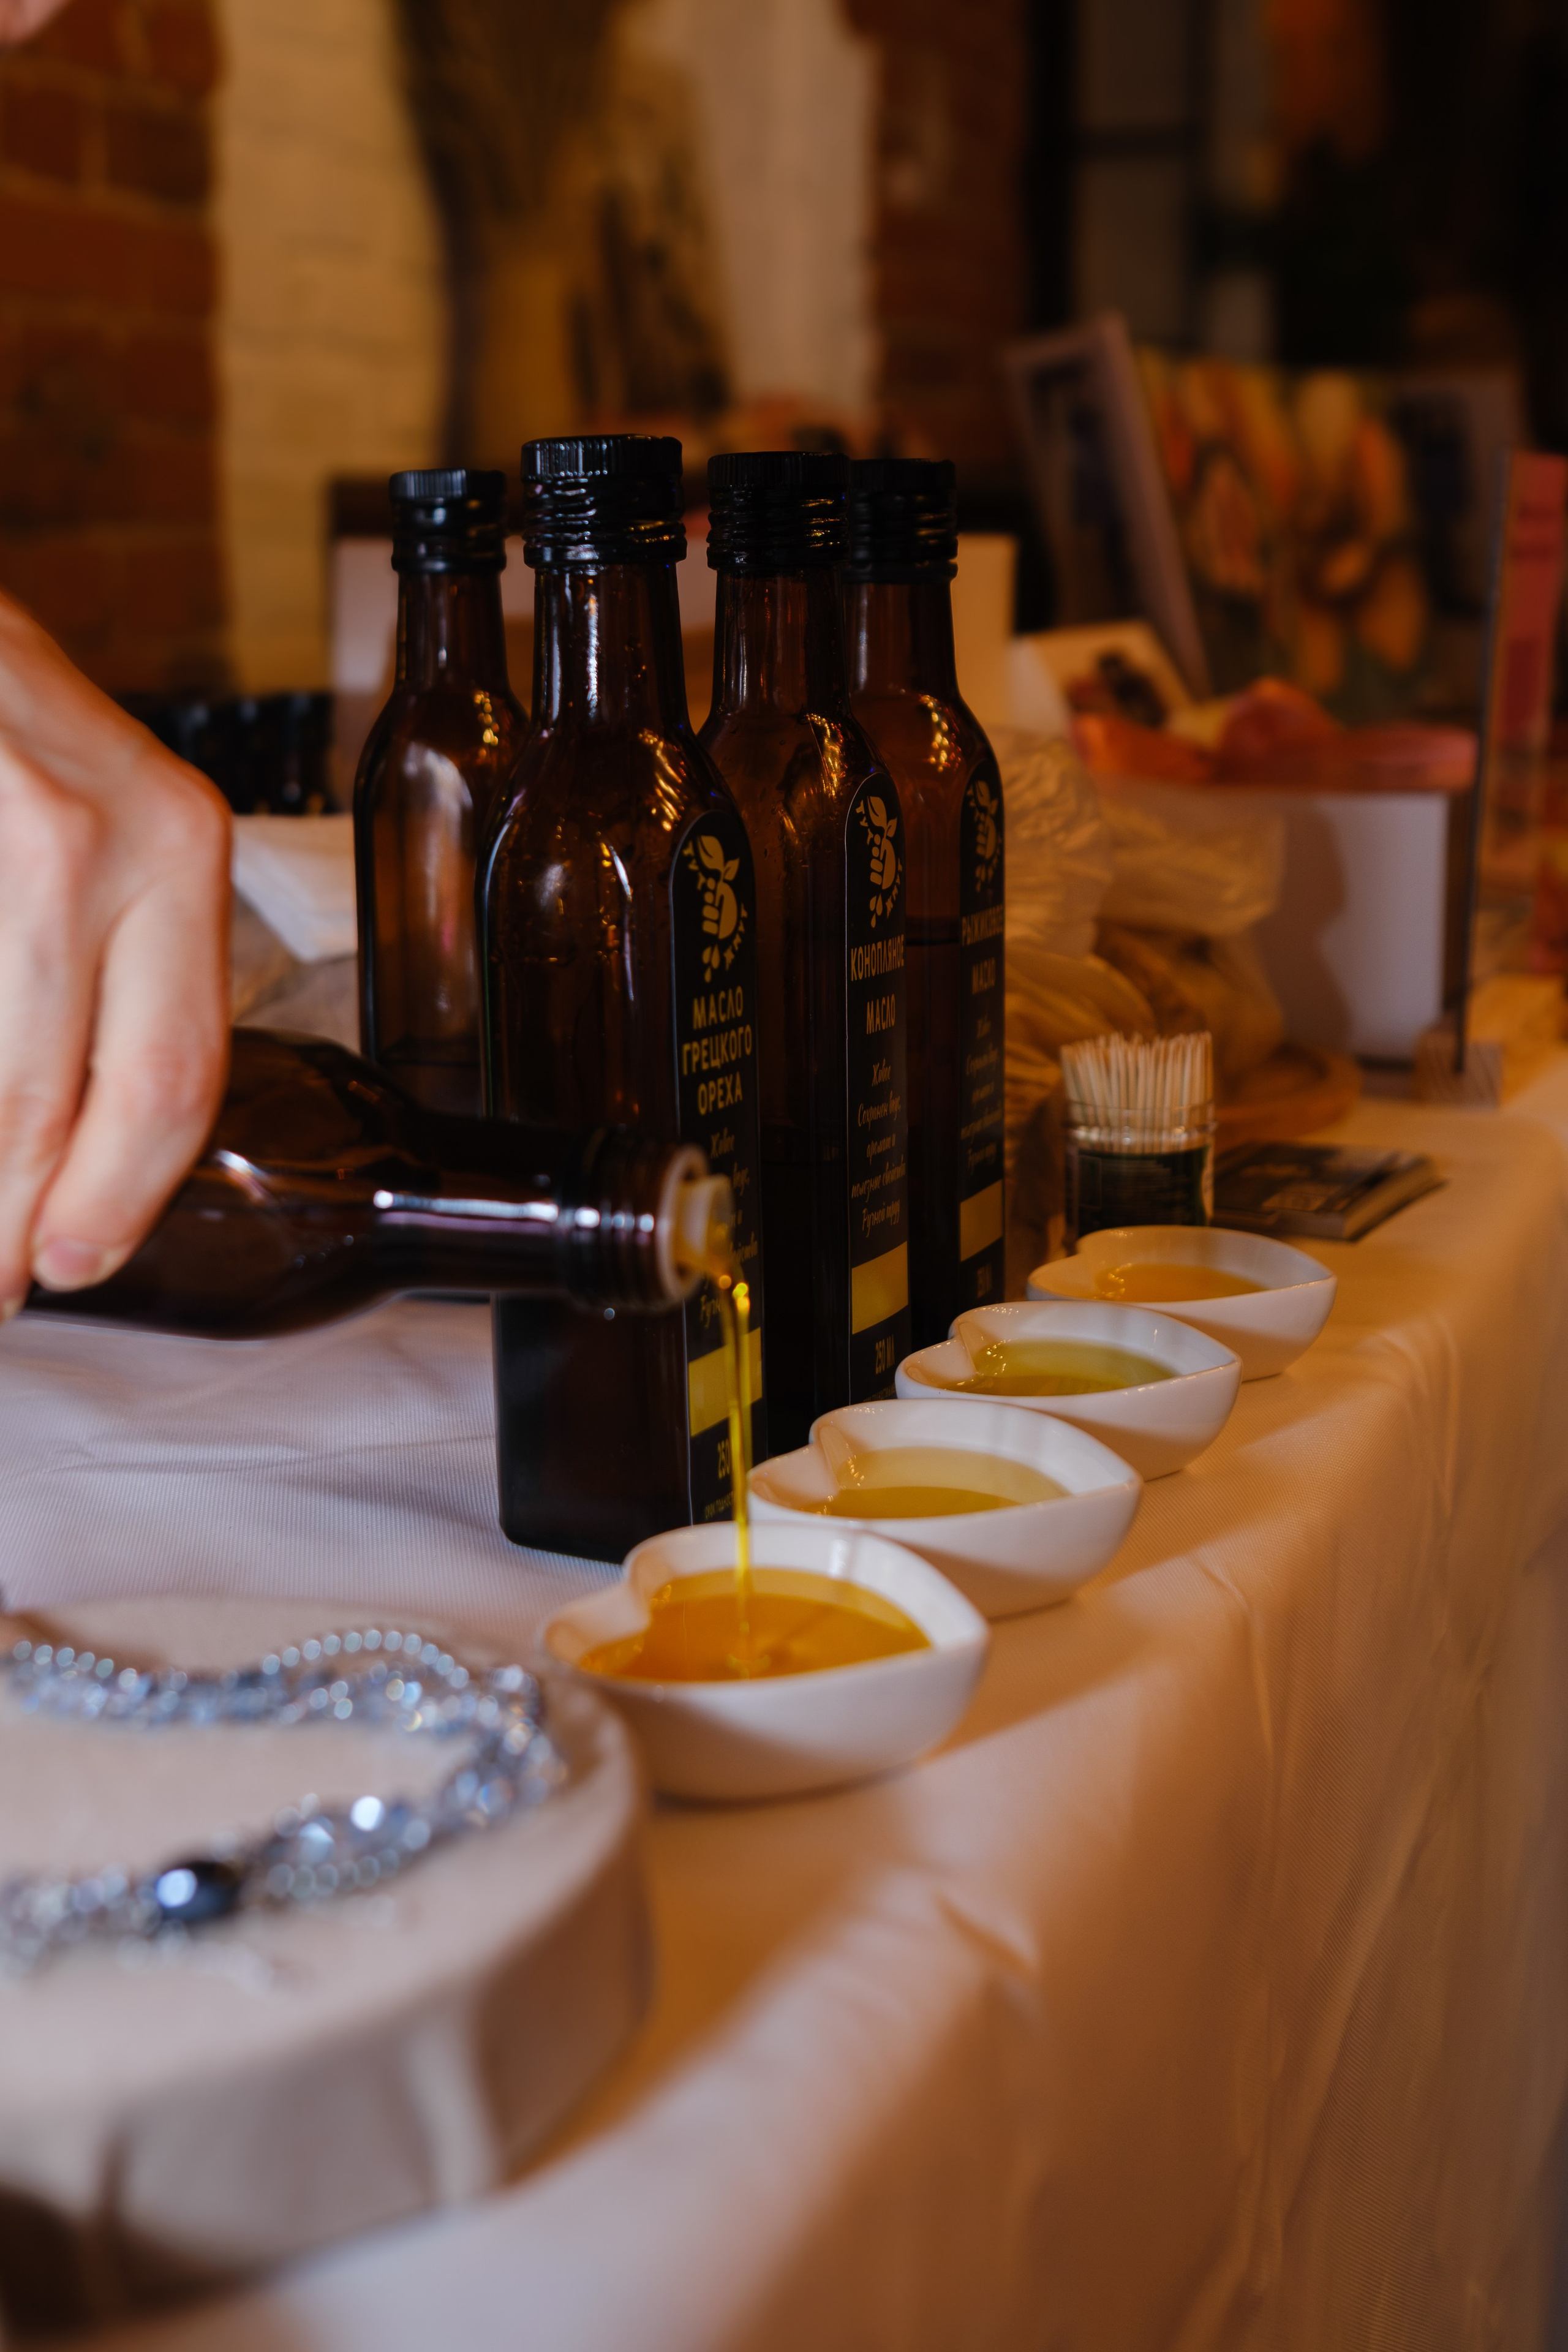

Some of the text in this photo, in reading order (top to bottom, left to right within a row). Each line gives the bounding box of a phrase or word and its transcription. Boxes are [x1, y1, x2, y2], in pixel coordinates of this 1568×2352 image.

[850, 933, 905, 982] КОНОПЛЯНОЕ
[971, 956, 997, 995] МАСЛО
[693, 986, 743, 1030] МАСЛО
[866, 993, 895, 1035] МАСЛО
[682, 1024, 752, 1076] ГРЕЦКОГО
[698, 1071, 743, 1115] ОРЕХА
[866, 1136, 891, 1166] аромат
[862, 1200, 885, 1238] Ручной
[875, 1338, 886, 1375] 250
[717, 1438, 731, 1481] 250
